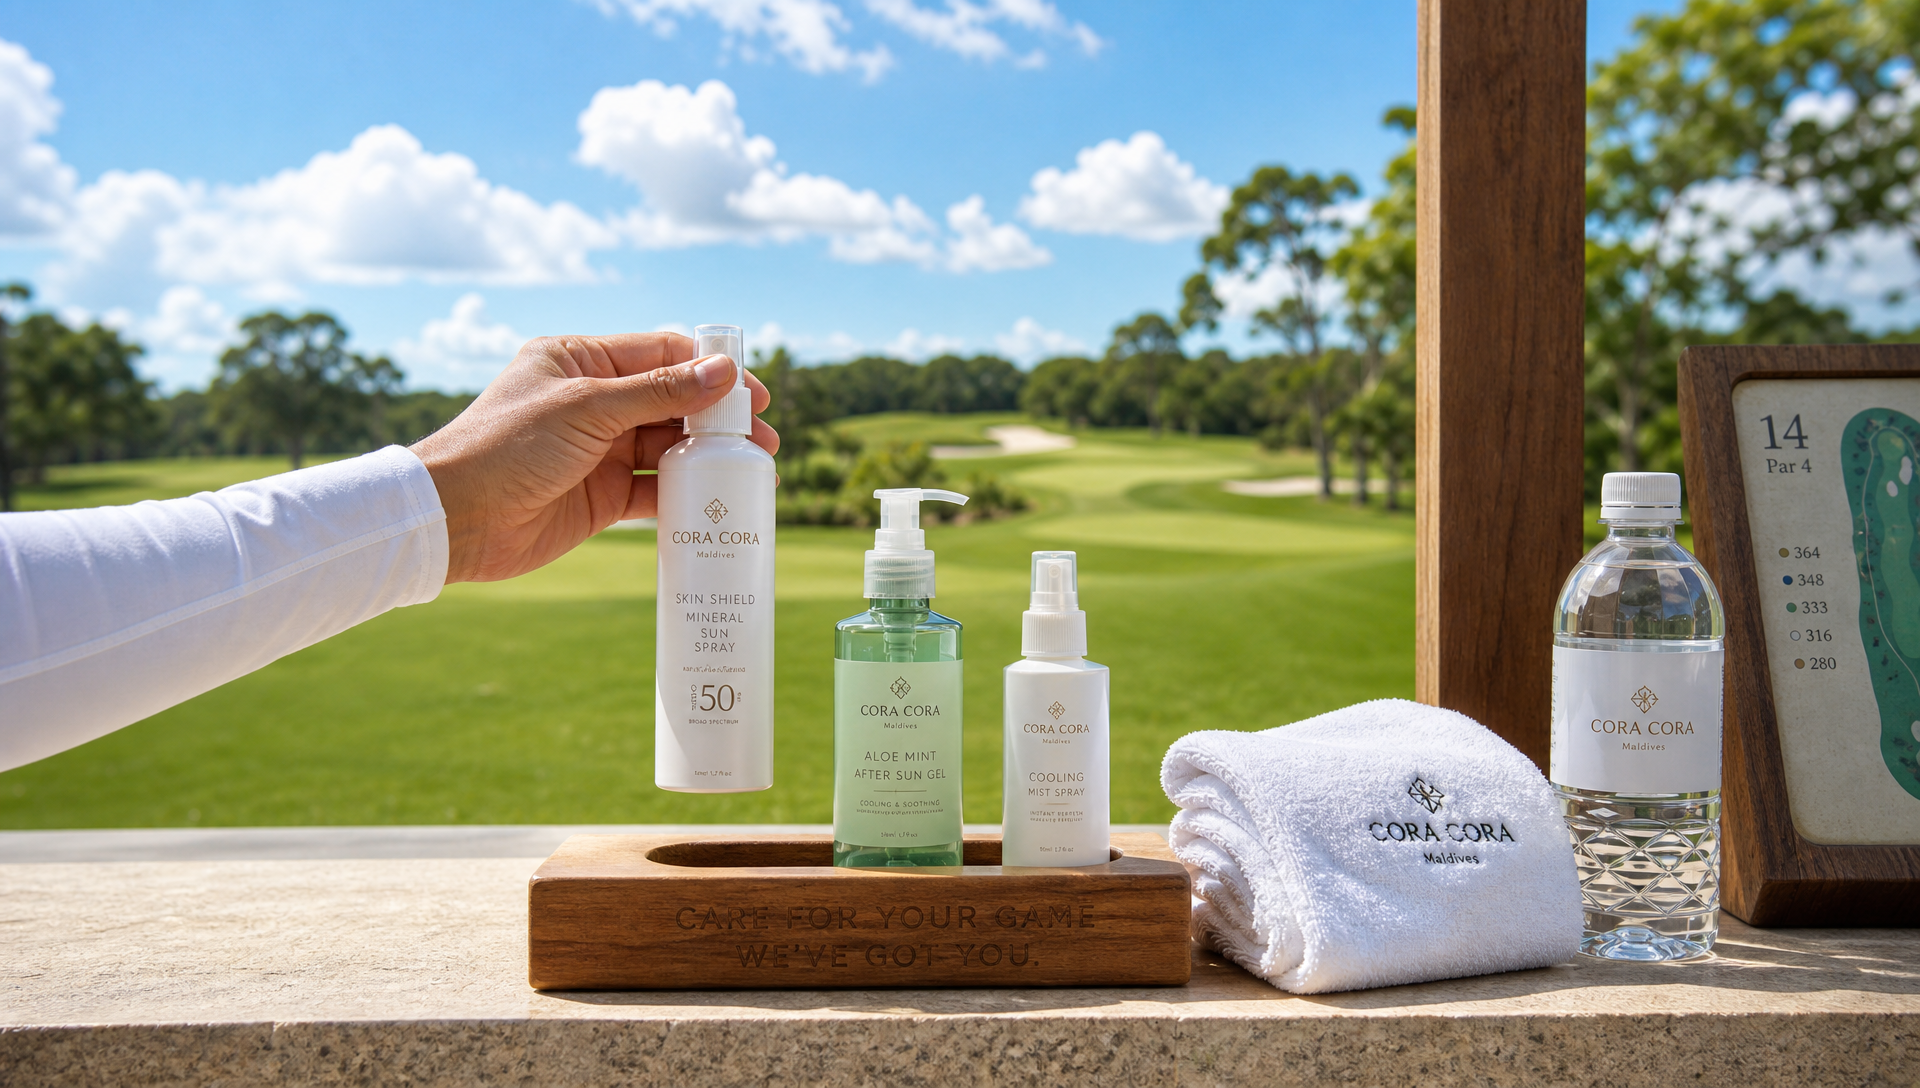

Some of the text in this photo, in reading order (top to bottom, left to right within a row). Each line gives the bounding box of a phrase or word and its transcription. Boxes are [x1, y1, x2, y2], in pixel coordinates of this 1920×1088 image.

[1760, 413, 1809, 449] 14
[1766, 458, 1812, 473] Par 4
[672, 531, 760, 545] CORA CORA
[1794, 546, 1820, 559] 364
[1797, 573, 1824, 586] 348
[676, 593, 755, 605] SKIN SHIELD
[1801, 601, 1828, 614] 333
[686, 612, 744, 623] MINERAL
[701, 627, 728, 638] SUN
[1805, 629, 1832, 642] 316
[694, 641, 735, 652] SPRAY
[1809, 657, 1837, 670] 280
[700, 684, 735, 711] 50
[860, 704, 940, 717] CORA CORA
[1023, 723, 1090, 734] CORA CORA
[1591, 719, 1694, 735] CORA CORA
[1622, 742, 1666, 751] Maldives
[864, 751, 936, 762] ALOE MINT
[854, 768, 946, 780] AFTER SUN GEL
[1029, 772, 1084, 783] COOLING
[1028, 788, 1085, 797] MIST SPRAY
[903, 799, 940, 807] SOOTHING
[1369, 822, 1515, 842] CORA CORA
[1423, 853, 1479, 864] Maldives
[676, 905, 1095, 930] CARE FOR YOUR GAME
[865, 943, 939, 967] GOT
[955, 943, 1039, 967] YOU.
